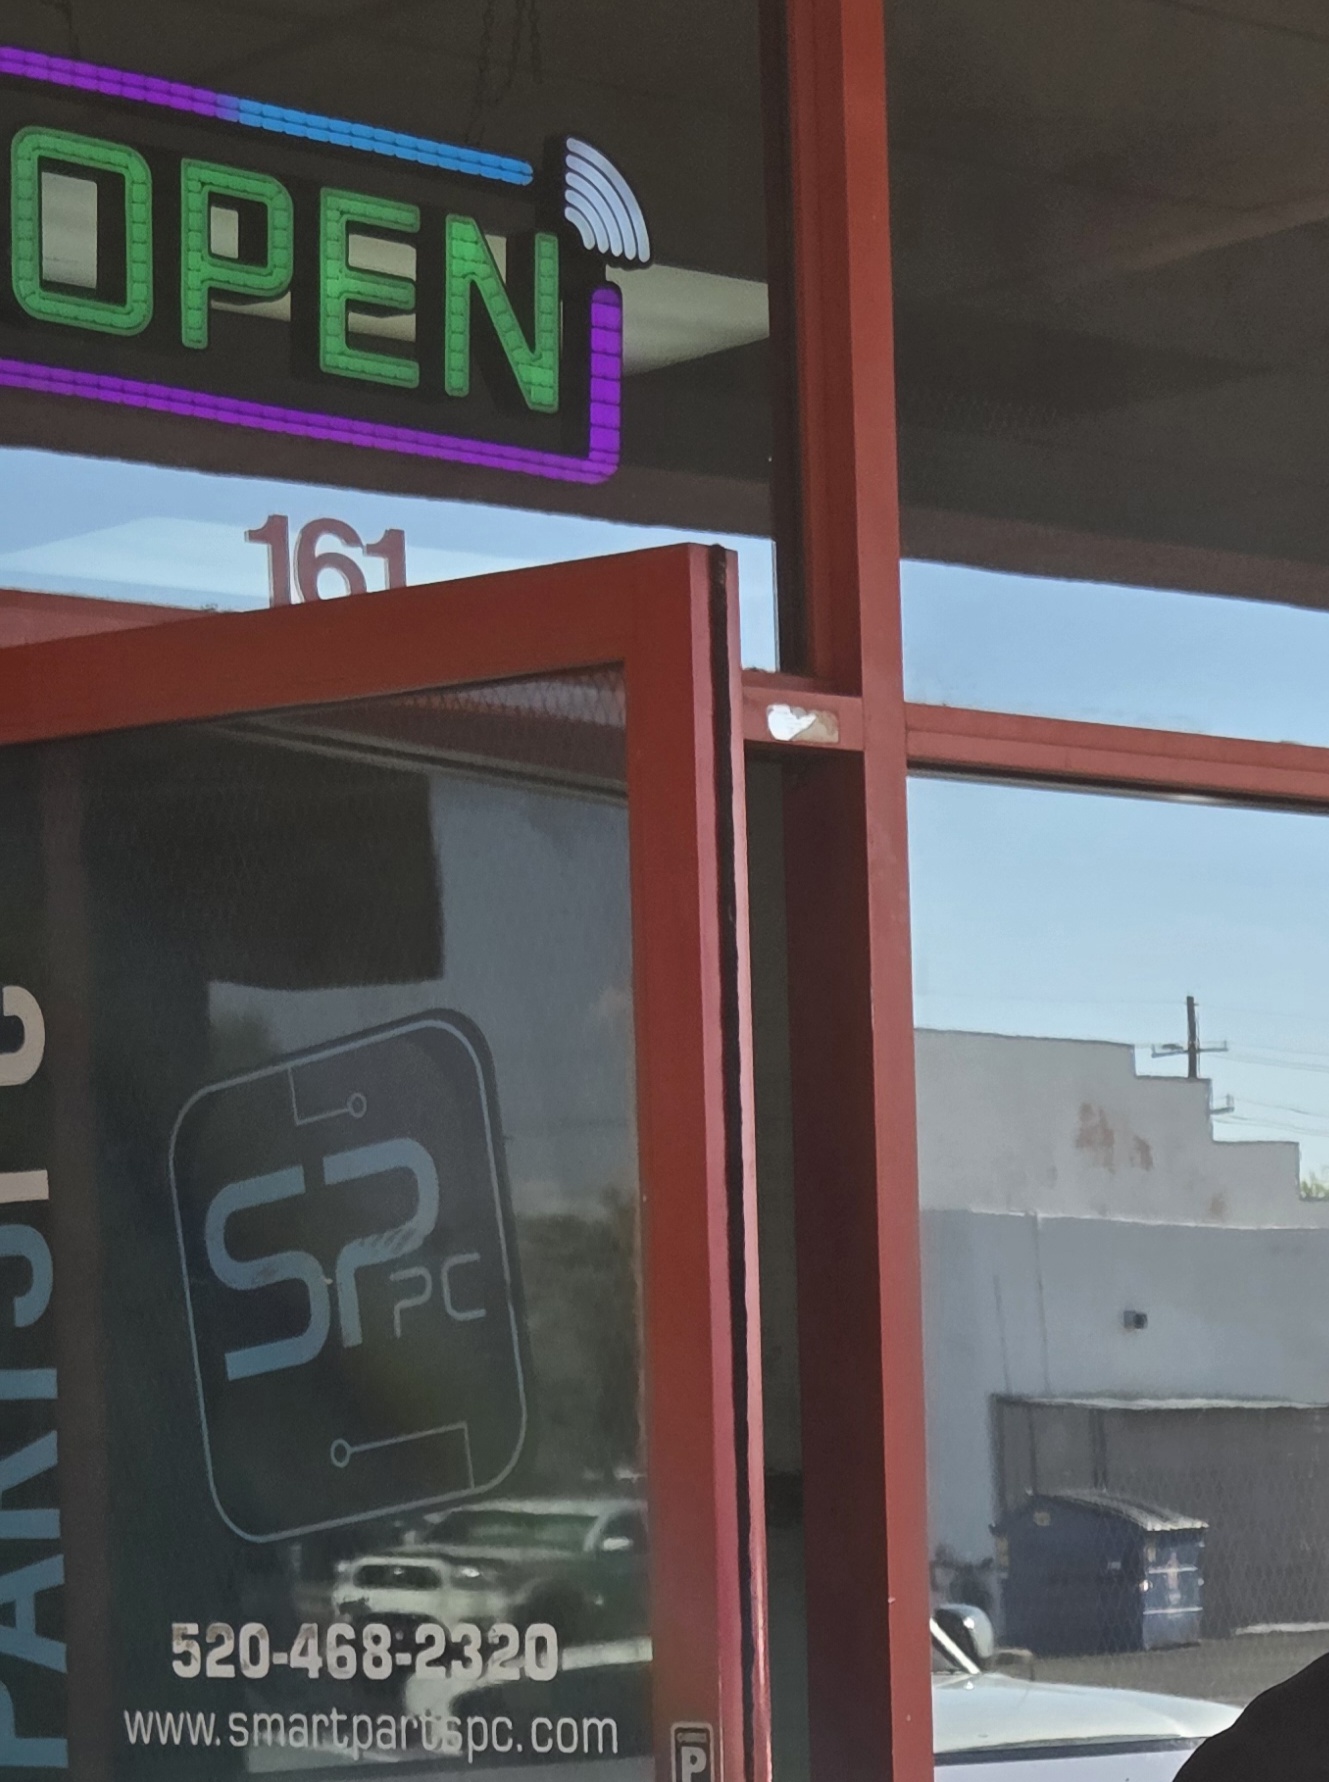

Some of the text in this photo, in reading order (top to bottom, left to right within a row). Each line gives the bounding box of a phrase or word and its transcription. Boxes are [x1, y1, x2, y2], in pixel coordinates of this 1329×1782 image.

[11, 126, 560, 414] OPEN
[244, 514, 407, 608] 161
[389, 1252, 487, 1338] PC
[171, 1622, 559, 1681] 520-468-2320
[123, 1706, 619, 1764] www.smartpartspc.com
